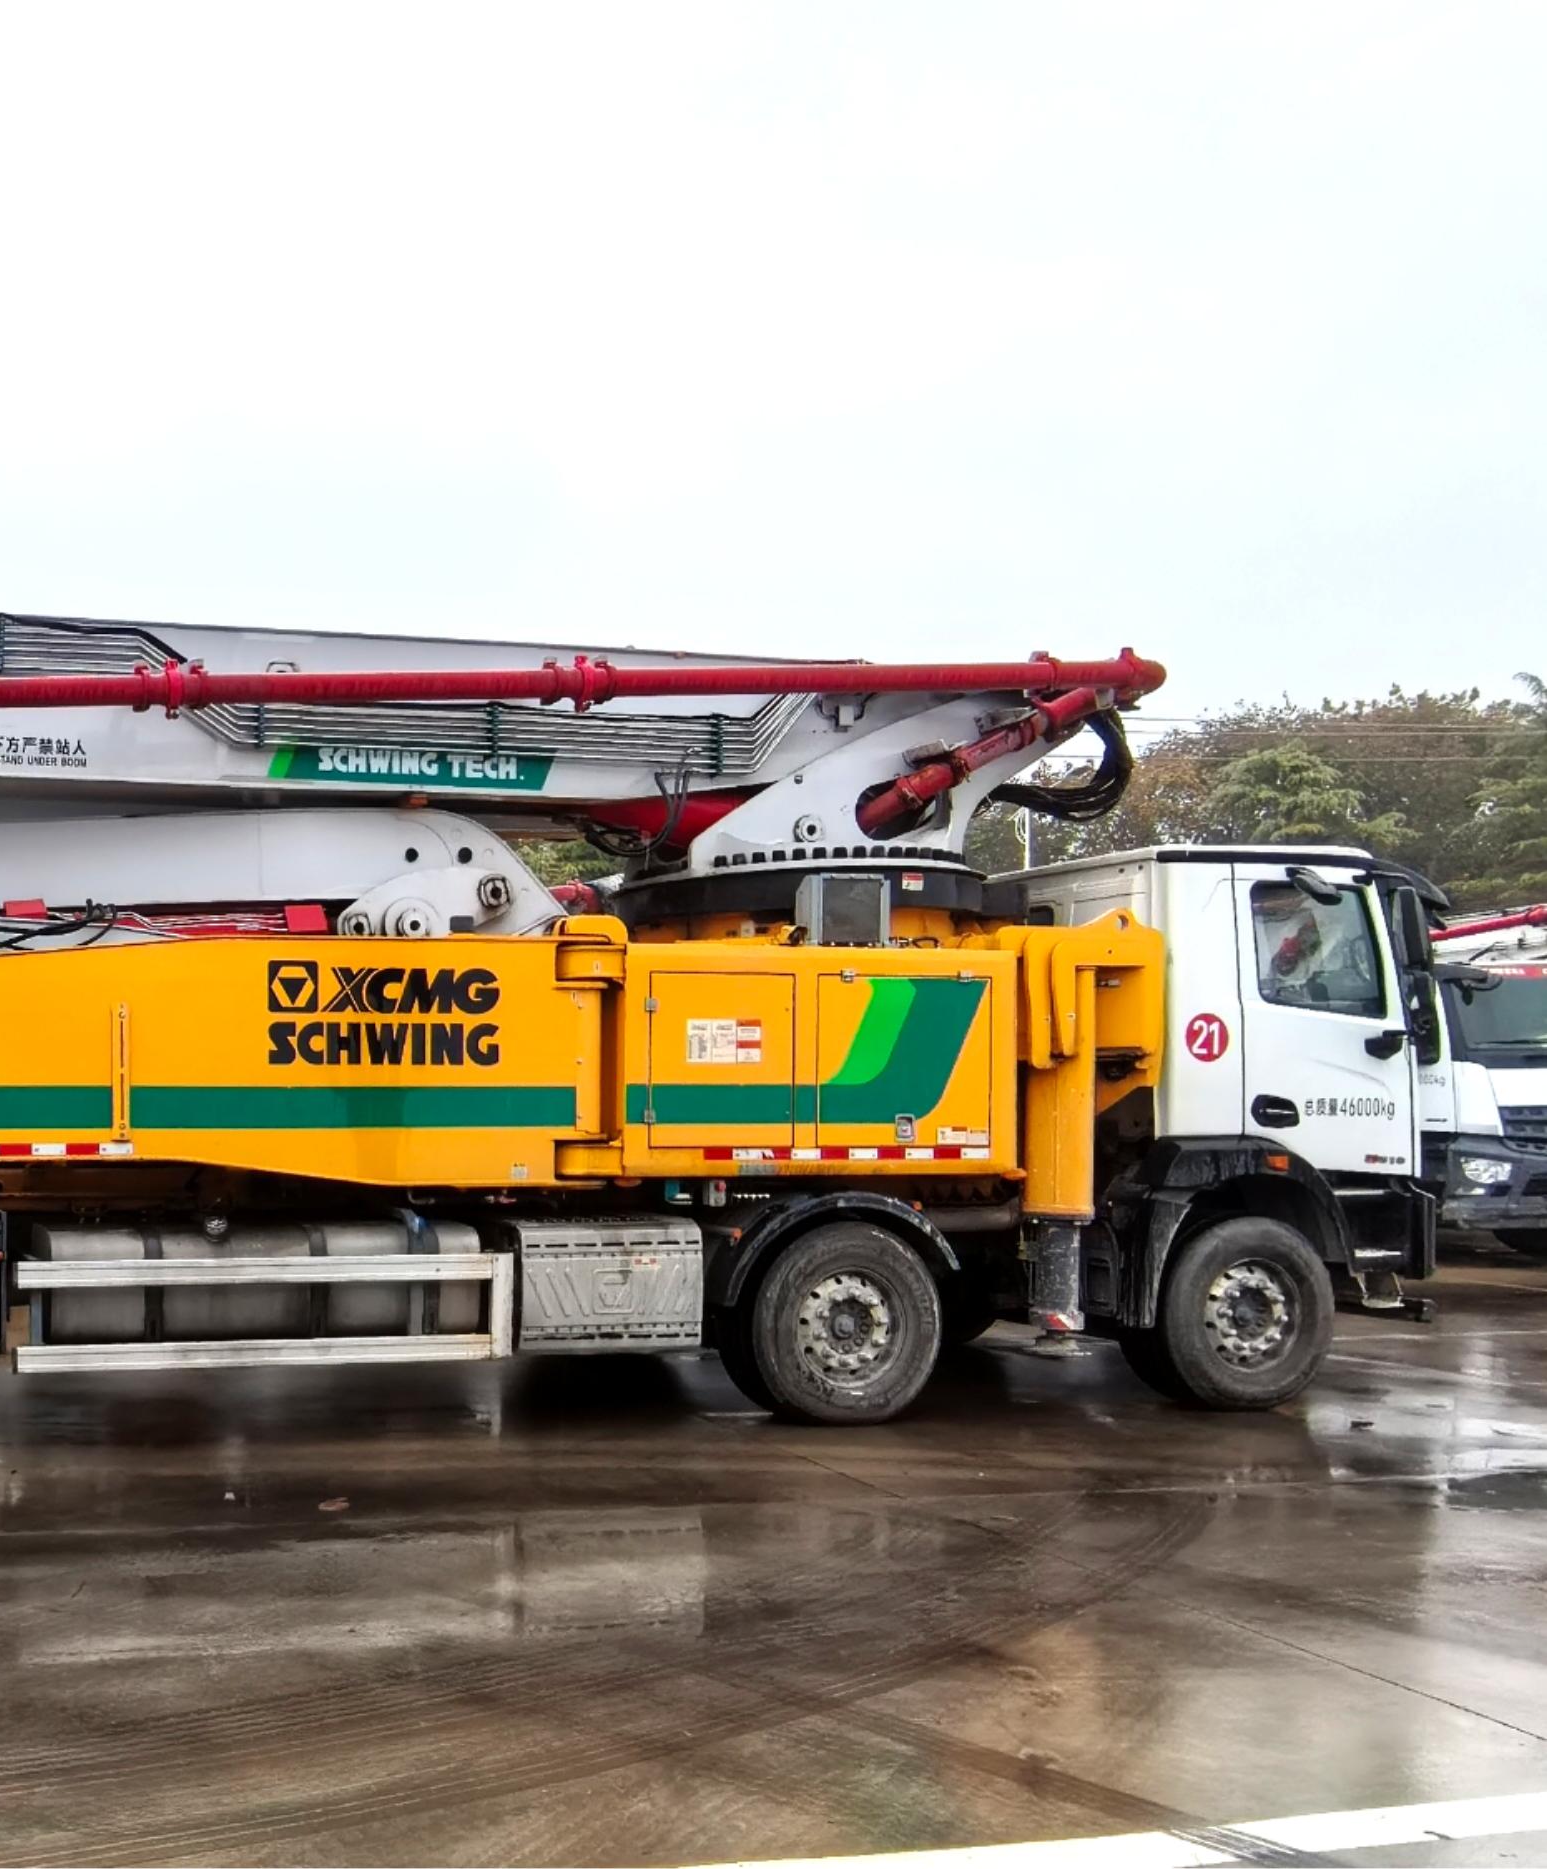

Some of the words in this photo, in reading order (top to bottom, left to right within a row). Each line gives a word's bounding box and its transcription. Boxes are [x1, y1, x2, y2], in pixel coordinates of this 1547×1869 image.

[27, 755, 57, 767] UNDER
[61, 757, 87, 768] BOOM
[318, 746, 438, 776] SCHWING
[447, 753, 525, 780] TECH.
[321, 966, 500, 1014] XCMG
[268, 1021, 500, 1067] SCHWING
[1192, 1019, 1220, 1056] 21
